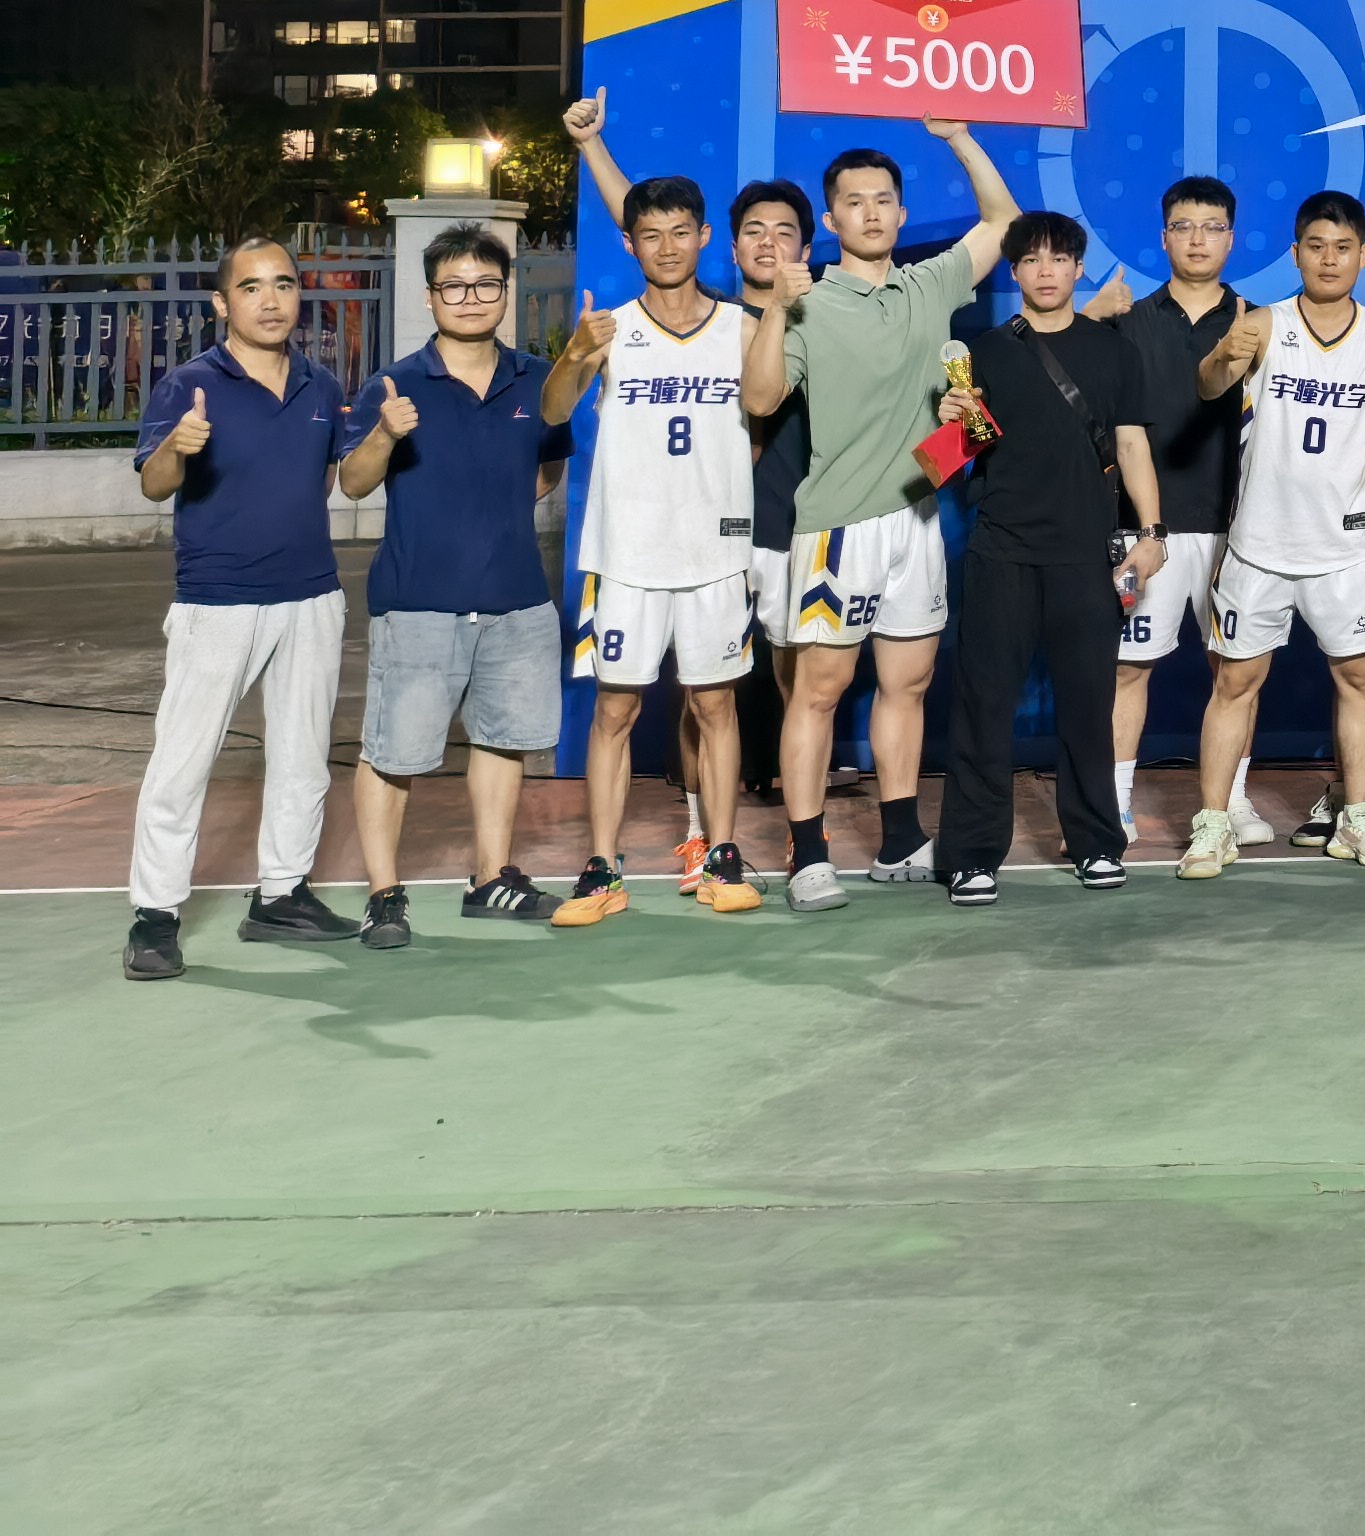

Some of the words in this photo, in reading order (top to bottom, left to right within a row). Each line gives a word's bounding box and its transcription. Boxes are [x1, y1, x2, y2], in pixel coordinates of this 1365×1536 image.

[834, 34, 1035, 96] ¥5000
[618, 376, 741, 406] 宇瞳光学
[668, 416, 691, 456] 8
[1302, 417, 1327, 454] 0
[846, 594, 881, 628] 26
[1223, 610, 1236, 639] 0
[602, 629, 623, 662] 8
